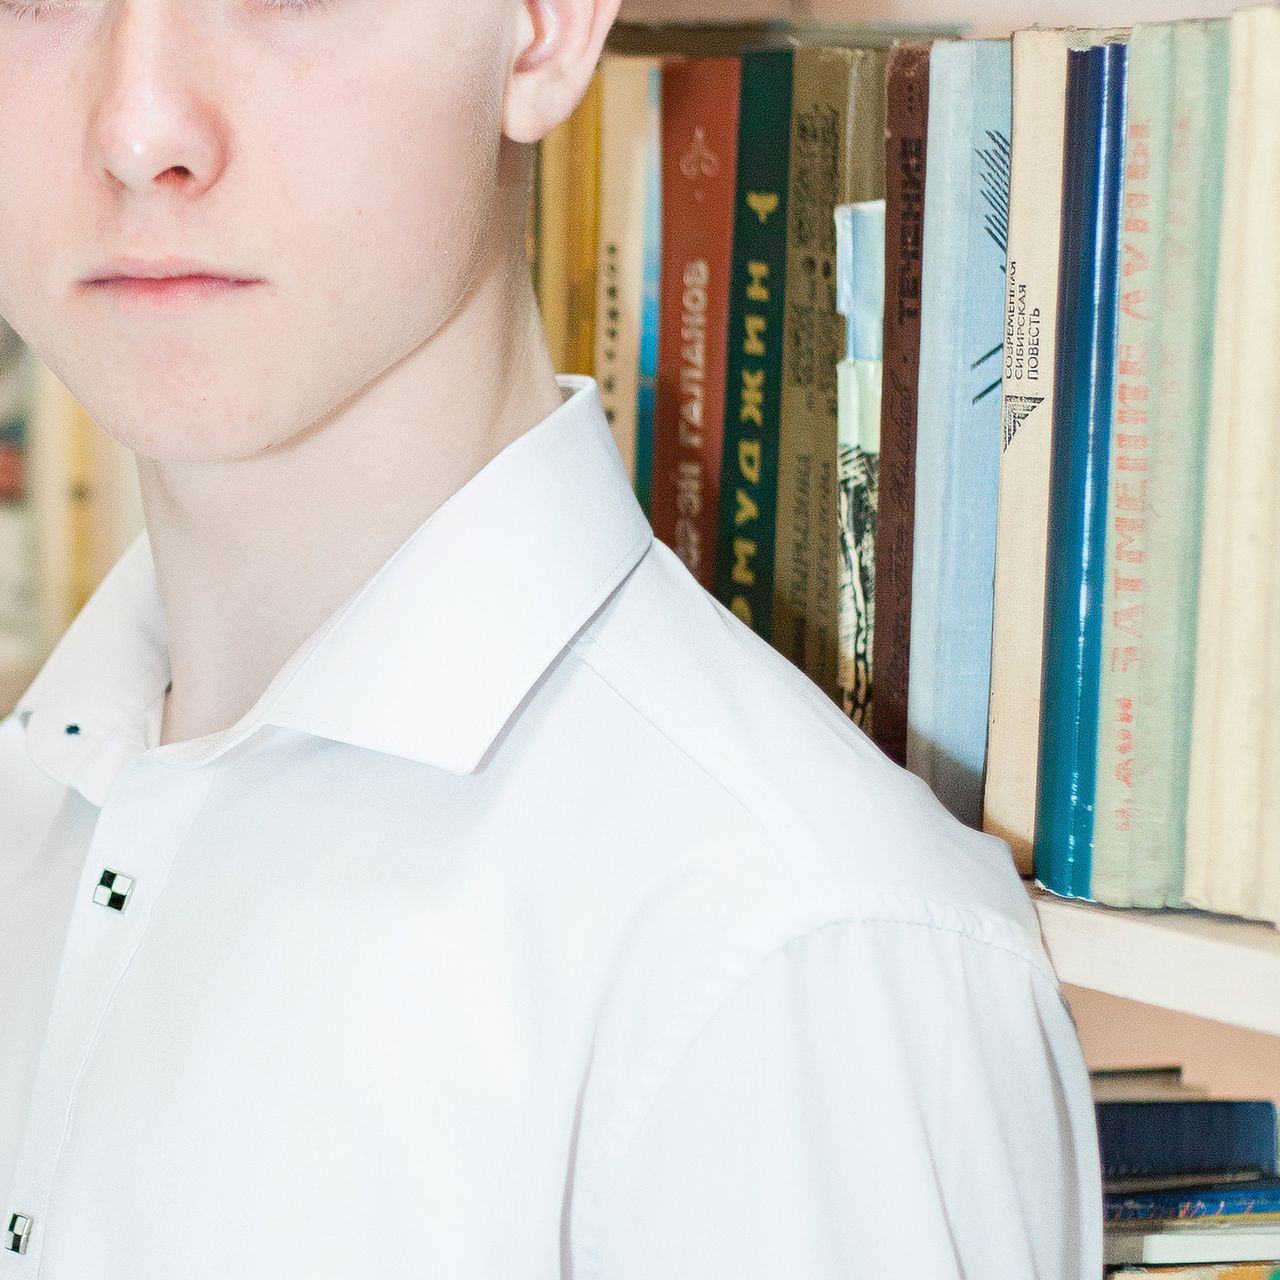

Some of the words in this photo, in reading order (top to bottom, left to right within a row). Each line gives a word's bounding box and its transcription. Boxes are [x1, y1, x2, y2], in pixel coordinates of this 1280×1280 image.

[898, 136, 921, 326] ТЕЧЕНИЕ
[1120, 122, 1151, 321] ЛУНЫ
[678, 259, 710, 449] ГАЛАНОВ
[1005, 261, 1017, 380] СОВРЕМЕННАЯ
[1014, 284, 1027, 381] СИБИРСКАЯ
[1027, 307, 1040, 381] ПОВЕСТЬ
[1111, 340, 1150, 674] ЗАТМЕНИЕ
